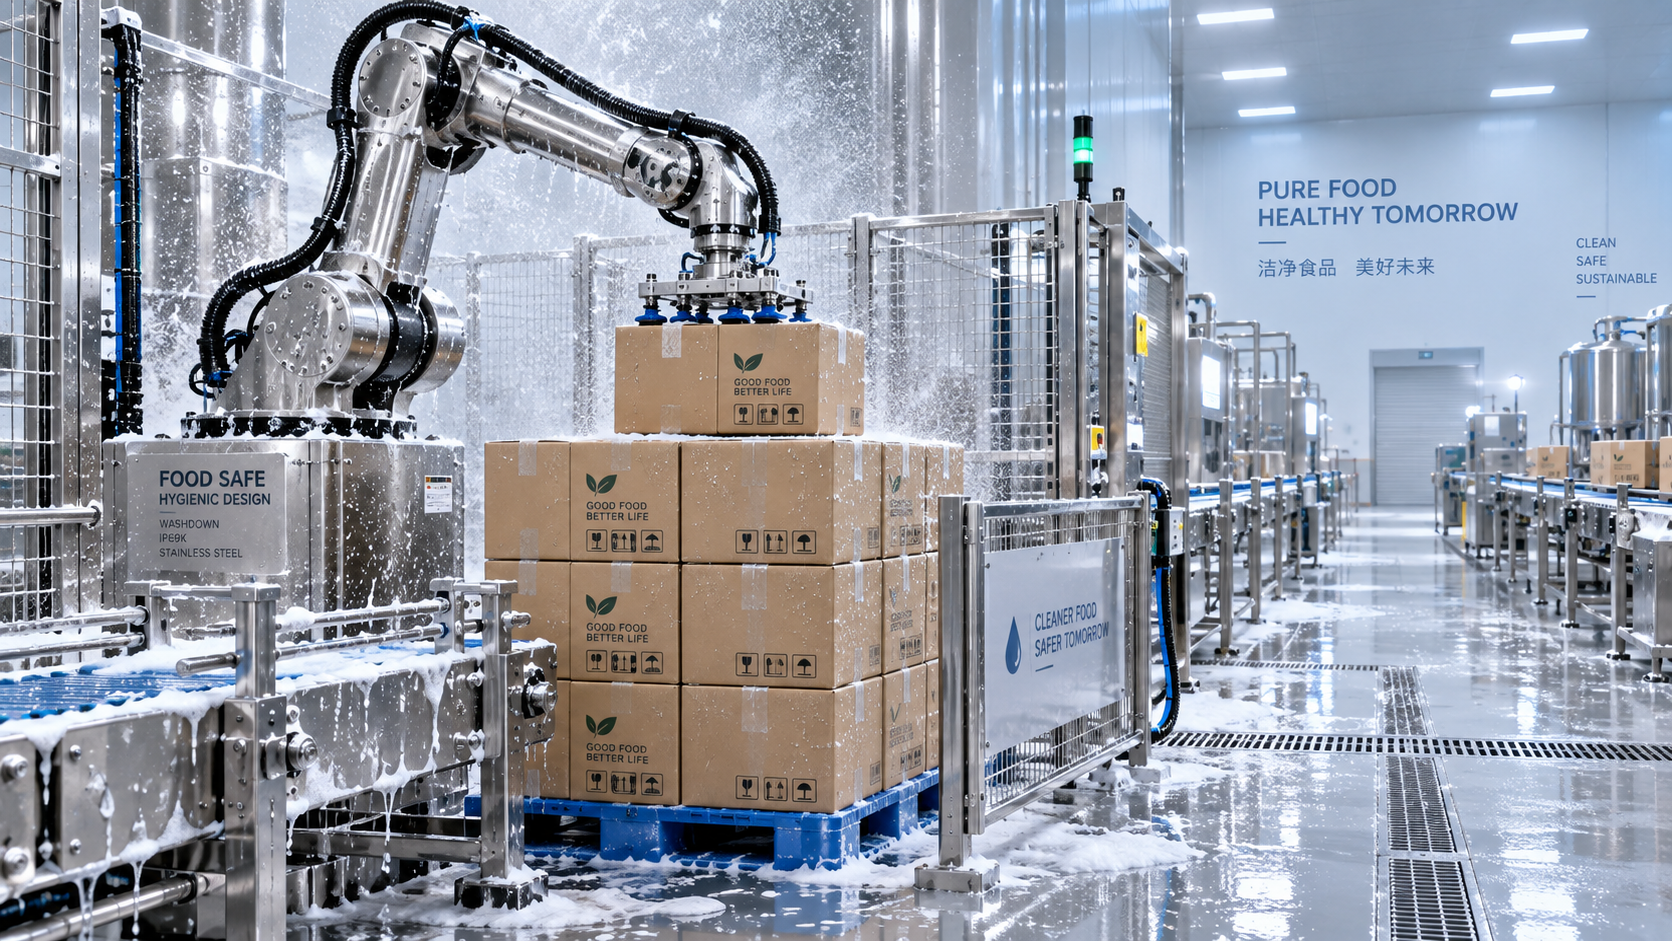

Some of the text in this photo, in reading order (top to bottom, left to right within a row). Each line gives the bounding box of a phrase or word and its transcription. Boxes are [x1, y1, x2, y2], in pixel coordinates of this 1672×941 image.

[1258, 178, 1397, 200] PURE FOOD
[1258, 202, 1519, 227] HEALTHY TOMORROW
[1575, 237, 1617, 249] CLEAN
[1258, 256, 1435, 278] 洁净食品 美好未来
[1576, 255, 1607, 267] SAFE
[1576, 272, 1658, 285] SUSTAINABLE
[734, 378, 790, 386] GOOD FOOD
[734, 388, 792, 396] BETTER LIFE
[159, 469, 266, 488] FOOD SAFE
[159, 492, 271, 506] HYGIENIC DESIGN
[586, 502, 648, 510] GOOD FOOD
[586, 512, 648, 520] BETTER LIFE
[158, 518, 220, 528] WASHDOWN
[160, 548, 242, 558] STAINLESS STEEL
[1035, 602, 1097, 631] CLEANER FOOD
[586, 622, 648, 632] GOOD FOOD
[586, 632, 648, 644] BETTER LIFE
[1034, 621, 1109, 657] SAFER TOMORROW
[586, 742, 646, 754] GOOD FOOD
[586, 752, 648, 764] BETTER LIFE
